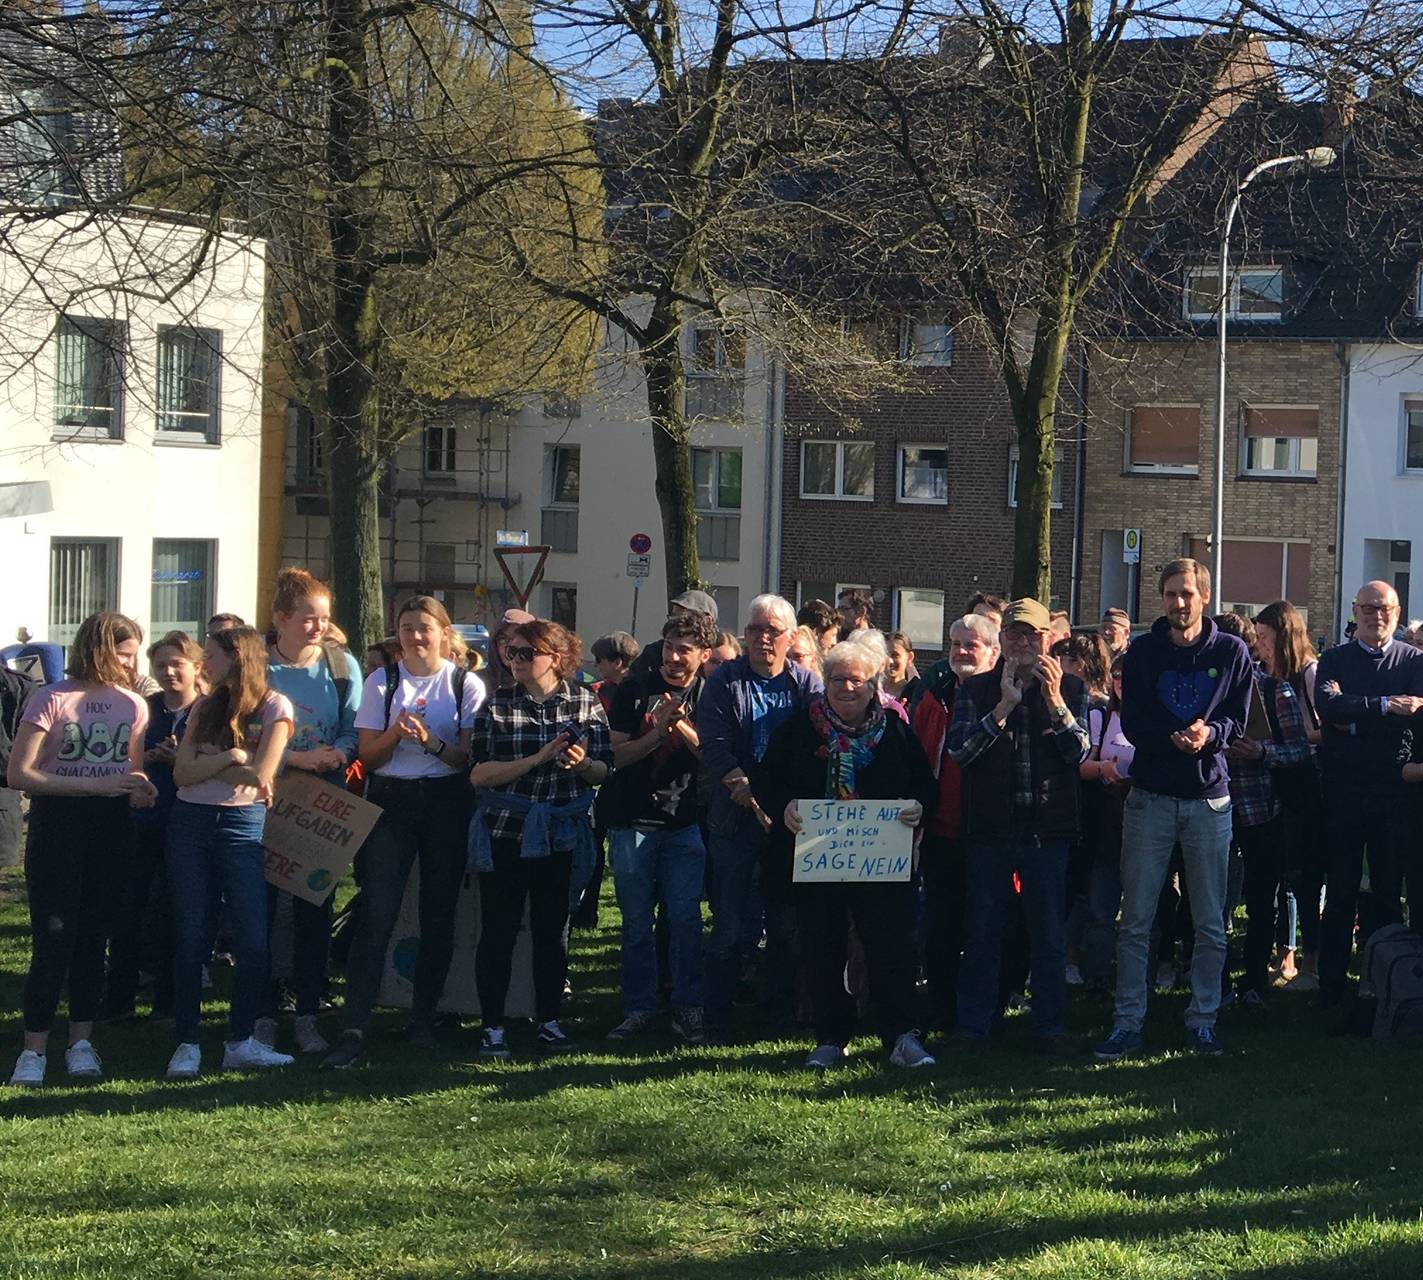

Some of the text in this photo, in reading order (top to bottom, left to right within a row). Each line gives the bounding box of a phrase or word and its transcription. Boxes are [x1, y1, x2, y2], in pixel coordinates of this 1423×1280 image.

[85, 701, 112, 714] HOLY
[312, 791, 357, 821] EURE
[811, 802, 867, 821] STEHE
[273, 797, 354, 847] UFGABEN
[818, 826, 838, 837] UND
[802, 852, 909, 877] SAGE NEIN
